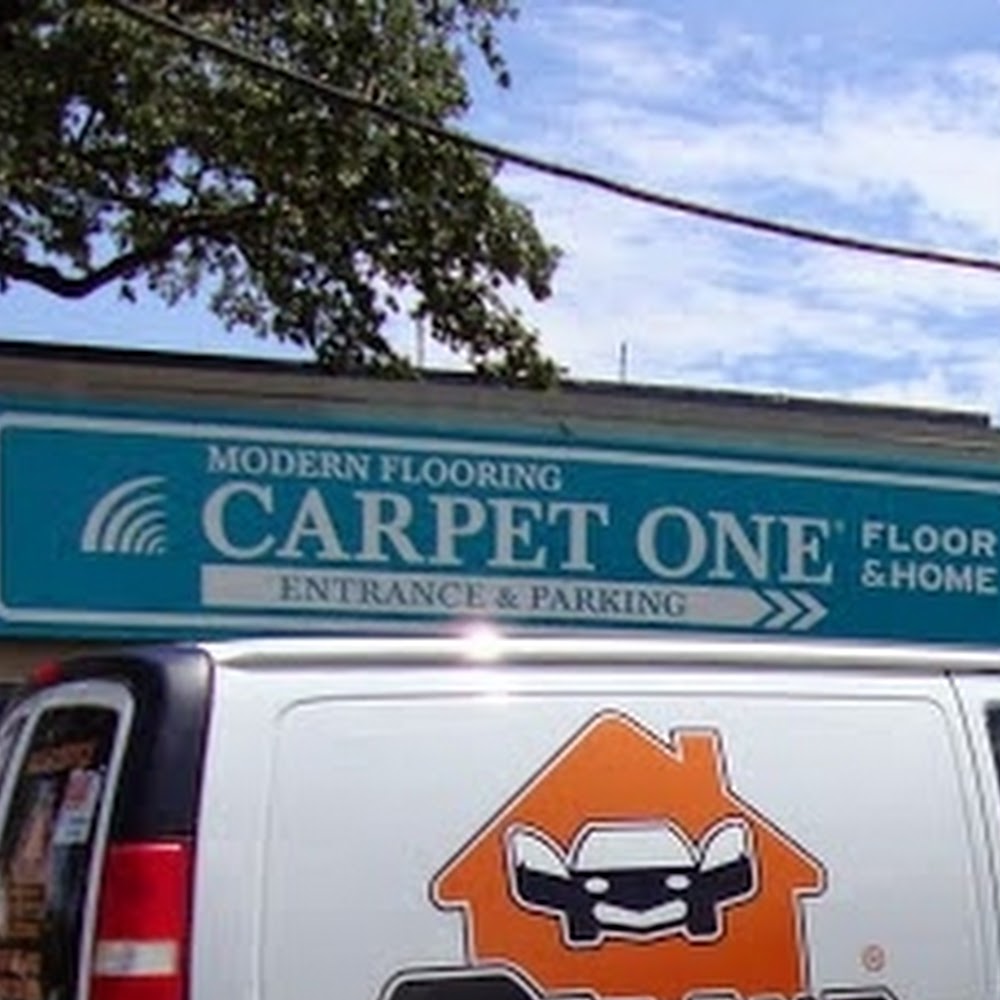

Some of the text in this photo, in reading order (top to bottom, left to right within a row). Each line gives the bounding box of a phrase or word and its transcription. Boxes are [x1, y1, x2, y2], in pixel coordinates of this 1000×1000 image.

[207, 445, 562, 491] MODERN FLOORING
[202, 481, 834, 585] CARPET ONE
[861, 521, 998, 558] FLOOR
[280, 574, 688, 617] ENTRANCE & PARKING
[860, 559, 999, 595] &HOME
